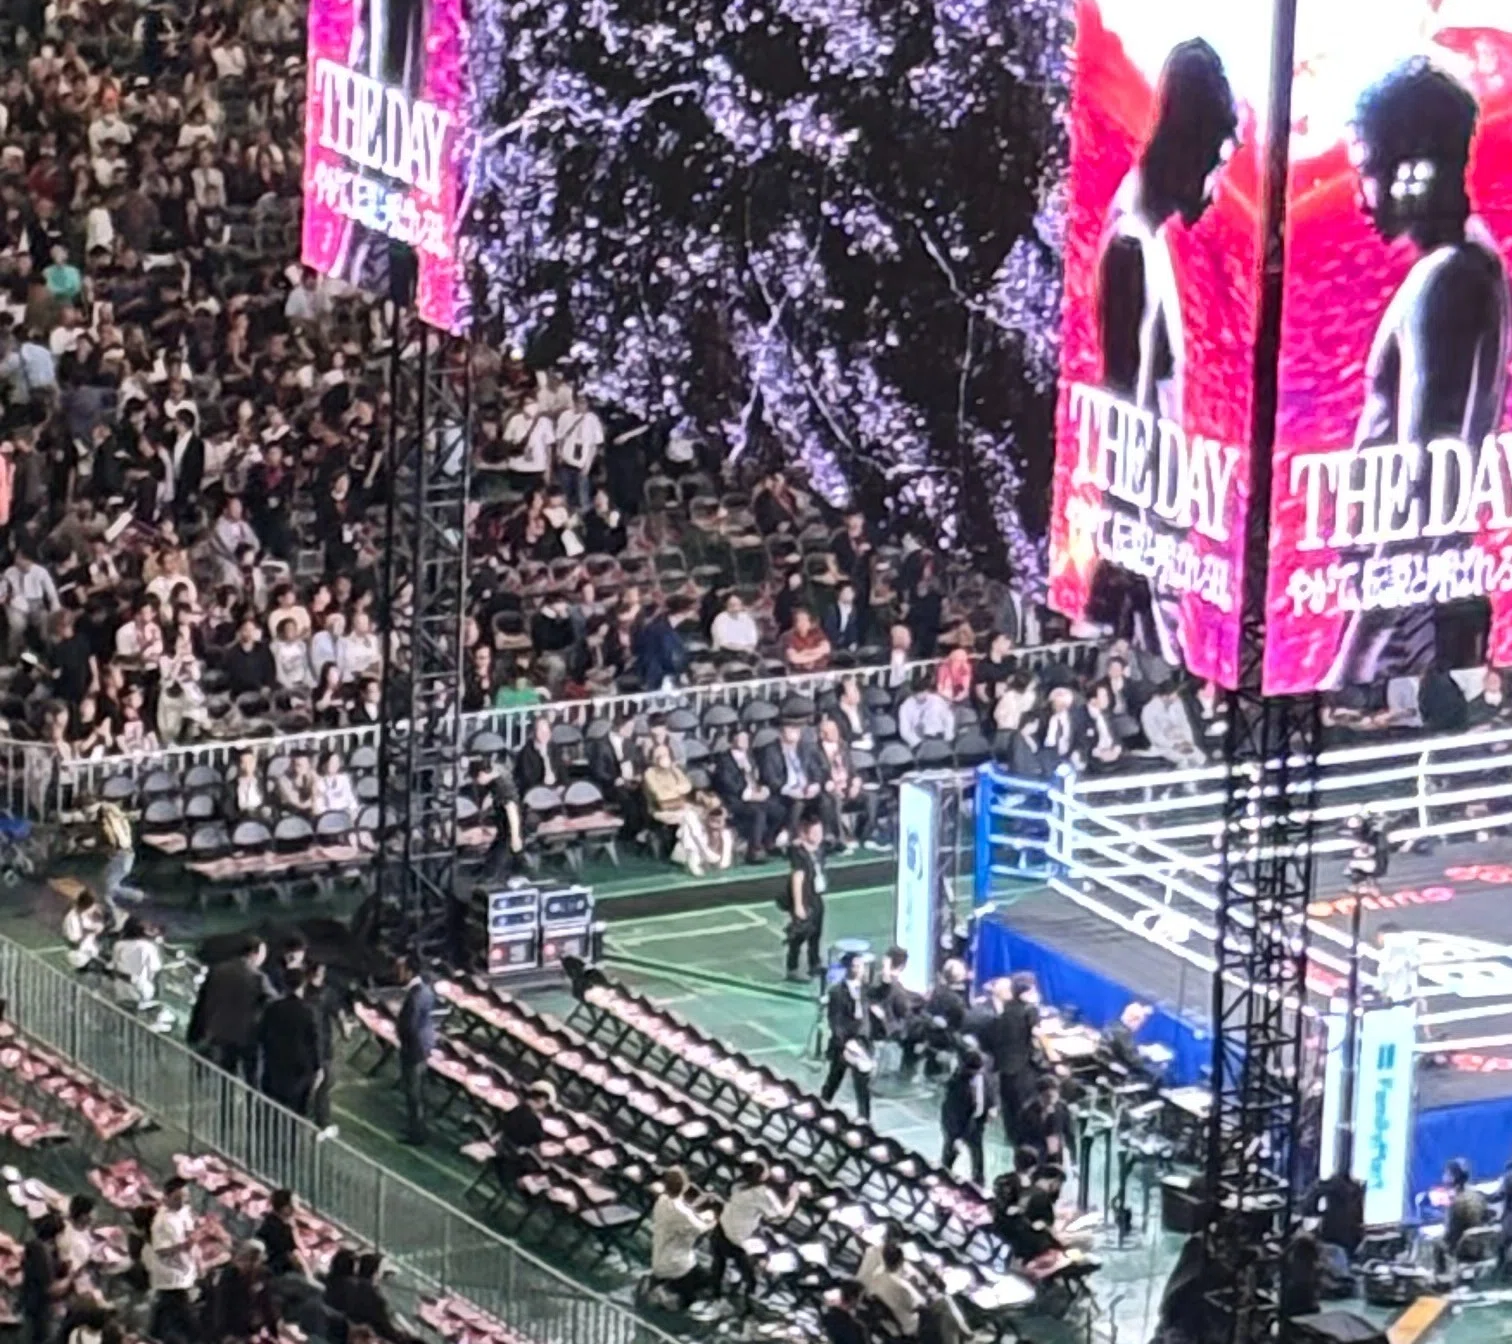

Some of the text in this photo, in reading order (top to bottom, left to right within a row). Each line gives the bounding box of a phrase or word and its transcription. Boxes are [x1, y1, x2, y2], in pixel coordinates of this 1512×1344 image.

[315, 58, 450, 201] THE DAY
[1070, 382, 1239, 542] THE DAY
[1289, 442, 1421, 551] THE
